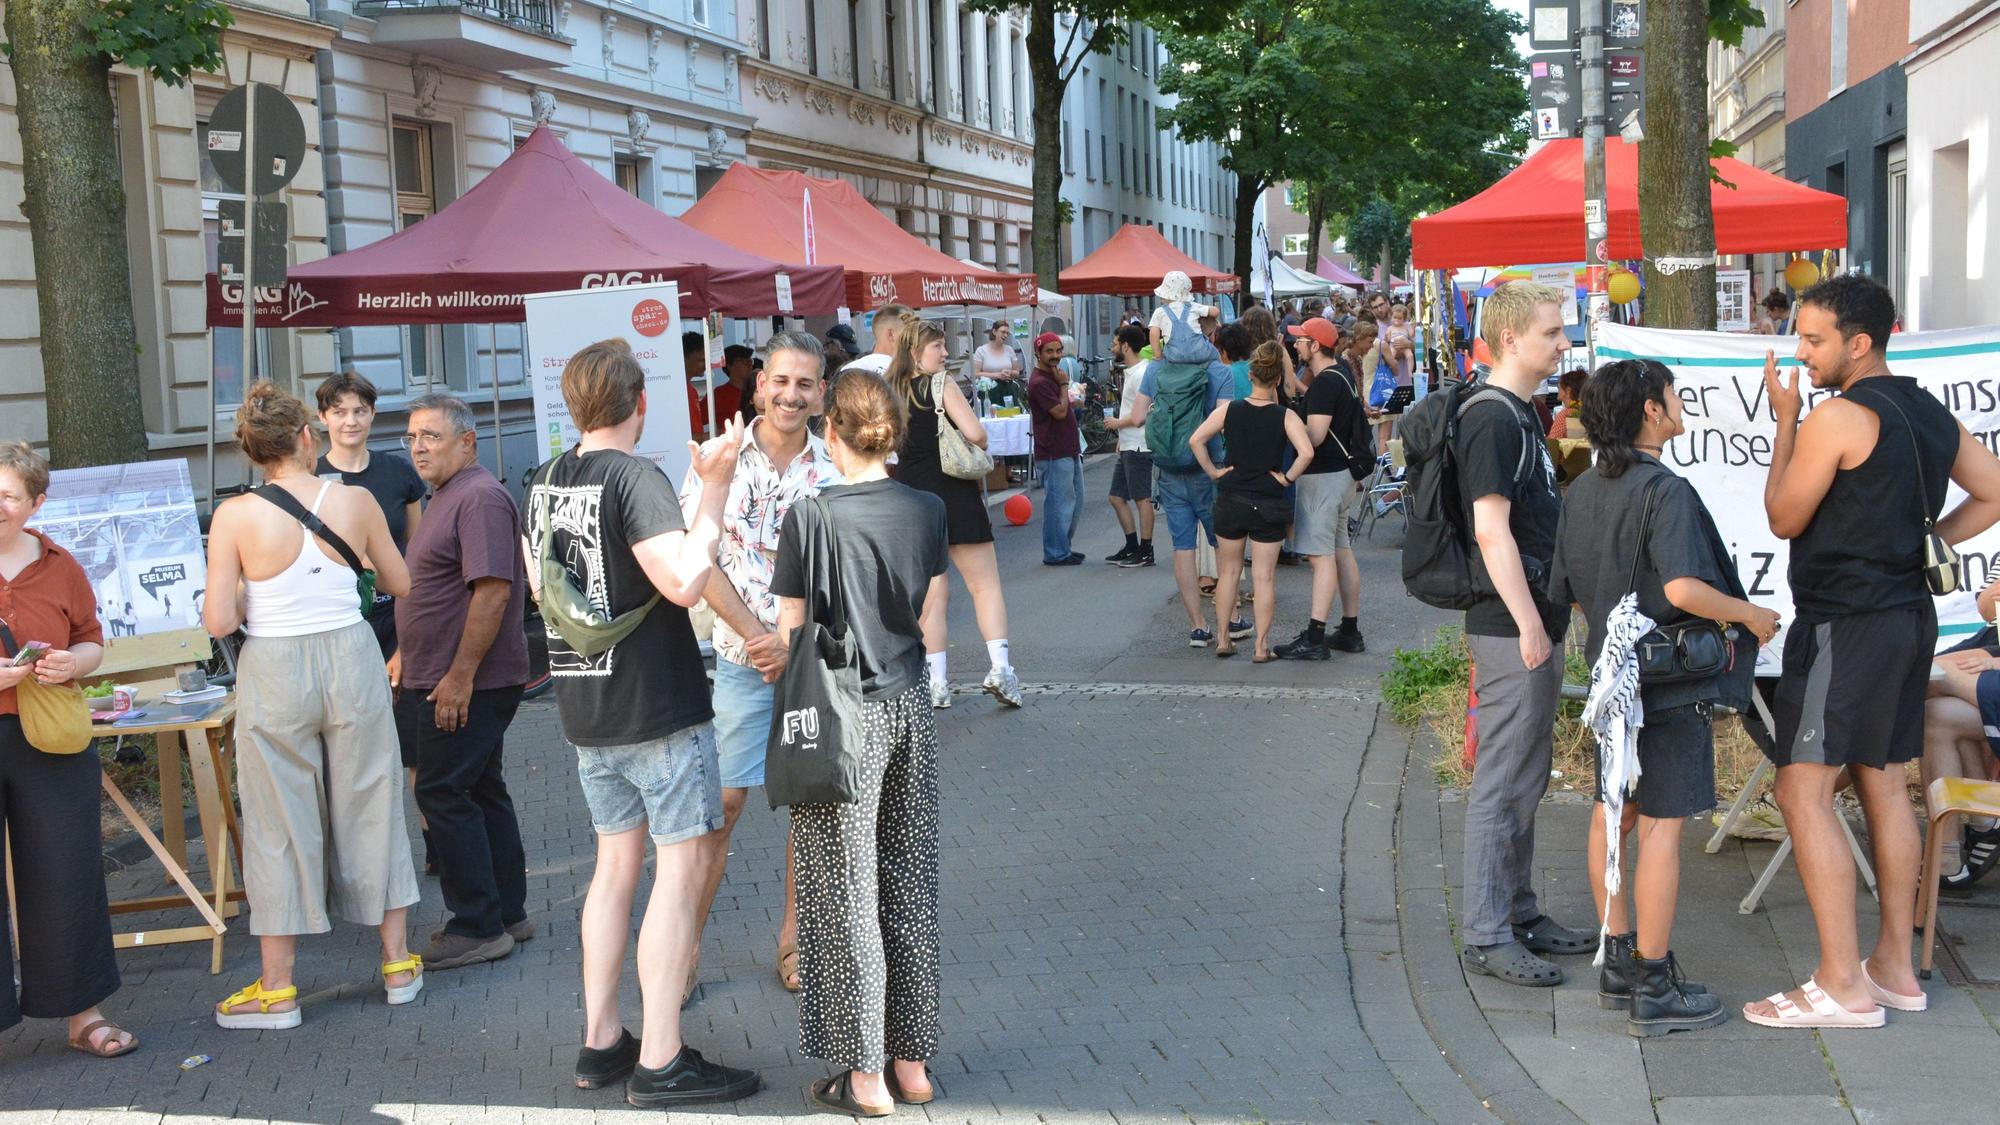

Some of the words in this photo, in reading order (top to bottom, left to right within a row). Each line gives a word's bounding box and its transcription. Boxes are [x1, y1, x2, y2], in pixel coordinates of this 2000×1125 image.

[221, 284, 282, 303] GG
[922, 276, 959, 301] Herzlich
[960, 276, 1004, 302] willkommen
[357, 292, 432, 309] Herzlich
[436, 291, 526, 308] willkomm
[223, 306, 268, 315] Immoien
[270, 306, 282, 314] AG
[1679, 386, 1720, 418] er
[1671, 428, 1772, 467] unse
[141, 570, 184, 584] SELMA
[154, 565, 181, 573] MUSEUM
[589, 583, 604, 610] CHI
